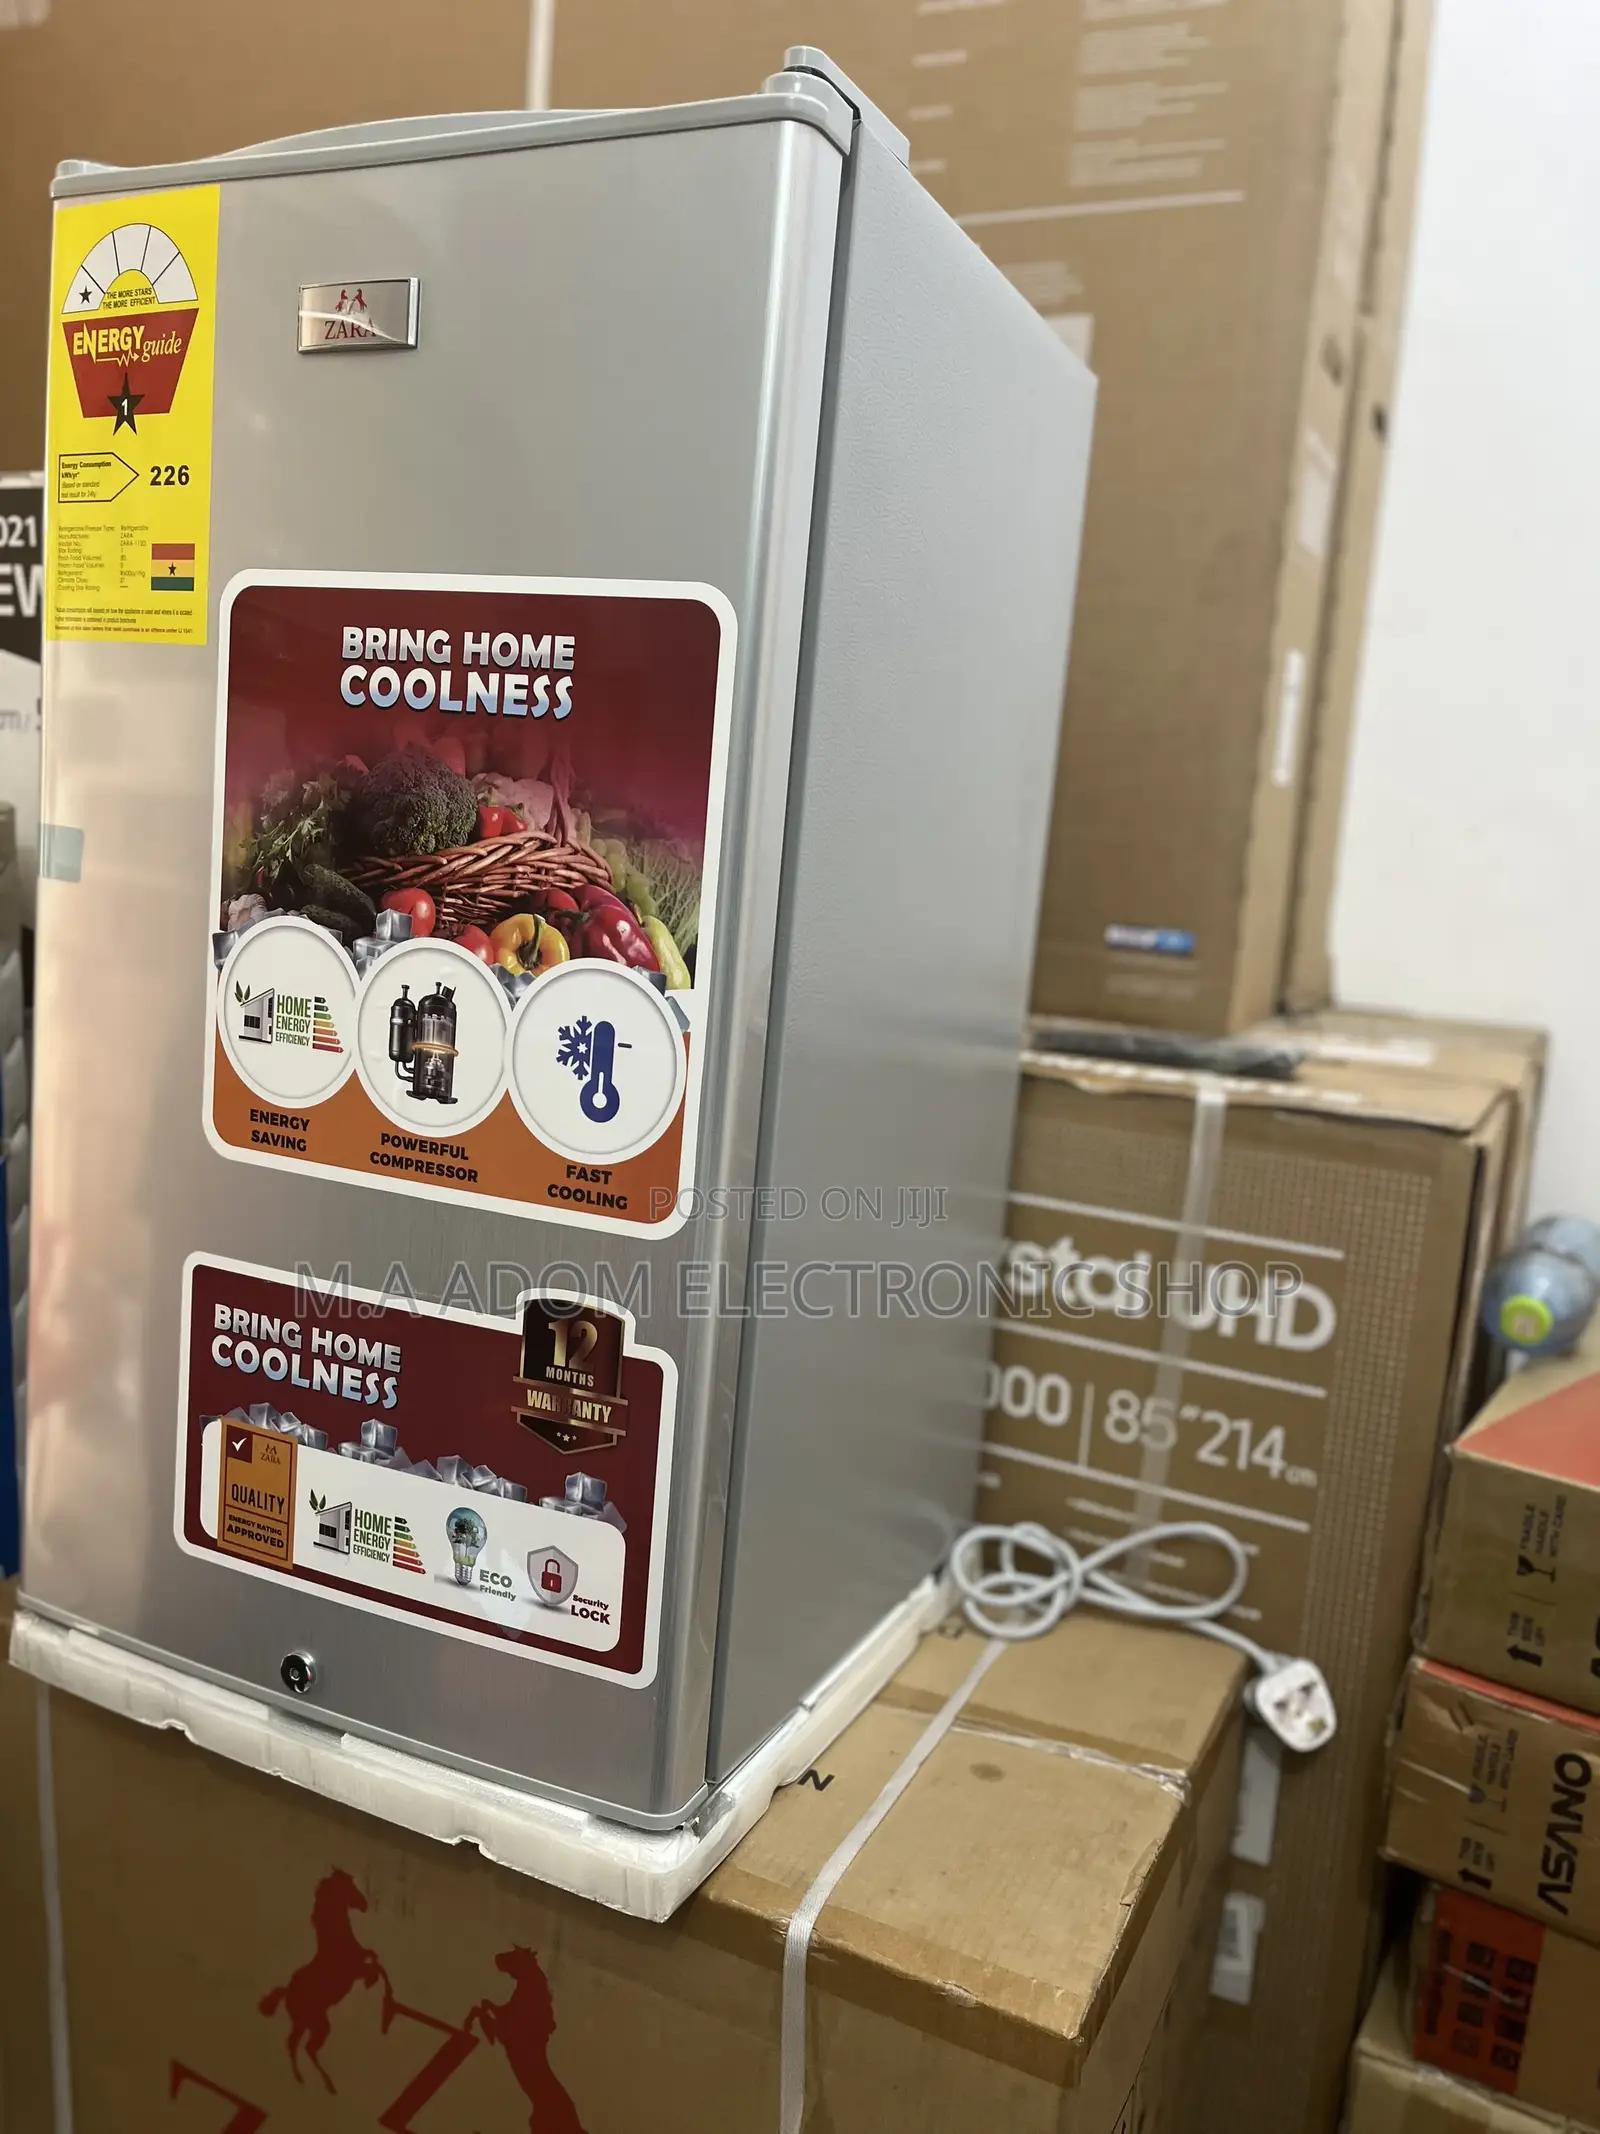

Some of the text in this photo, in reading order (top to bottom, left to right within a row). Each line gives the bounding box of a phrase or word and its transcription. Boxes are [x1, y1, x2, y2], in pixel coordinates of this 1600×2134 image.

[103, 296, 156, 310] THE MORE EFFICIENT
[106, 287, 153, 299] THE MORE STARS
[324, 317, 377, 340] ZARA
[73, 322, 182, 363] ENERGY guide
[121, 398, 128, 416] 1
[61, 460, 112, 470] Energy Consumption
[150, 465, 190, 486] 226
[342, 626, 576, 671] BRING HOME
[340, 665, 574, 720] COOLNESS
[276, 995, 312, 1019] HOME
[276, 1015, 311, 1034] ENERGY
[275, 1033, 311, 1047] EFFICIENCY
[250, 1108, 311, 1132] ENERGY
[251, 1129, 307, 1152] SAVING
[380, 1133, 469, 1161] POWERFUL
[370, 1152, 478, 1183] COMPRESSOR
[566, 1165, 613, 1185] FAST
[547, 1184, 628, 1210] COOLING
[214, 1303, 401, 1373] BRING HOME
[548, 1318, 598, 1372] 12
[211, 1334, 399, 1410] COOLNESS
[546, 1366, 595, 1388] MONTHS
[260, 1452, 281, 1466] ZARA
[231, 1484, 285, 1515] QUALITY
[228, 1514, 282, 1537] ENERGY RATING
[354, 1508, 392, 1537] HOME
[226, 1524, 285, 1549] APPROVED
[353, 1529, 391, 1550] ENERGY
[352, 1545, 391, 1564] EFFICIENCY
[479, 1568, 513, 1589] ECO
[479, 1584, 517, 1602] Friendly
[572, 1594, 610, 1611] Security
[570, 1604, 611, 1626] LOCK
